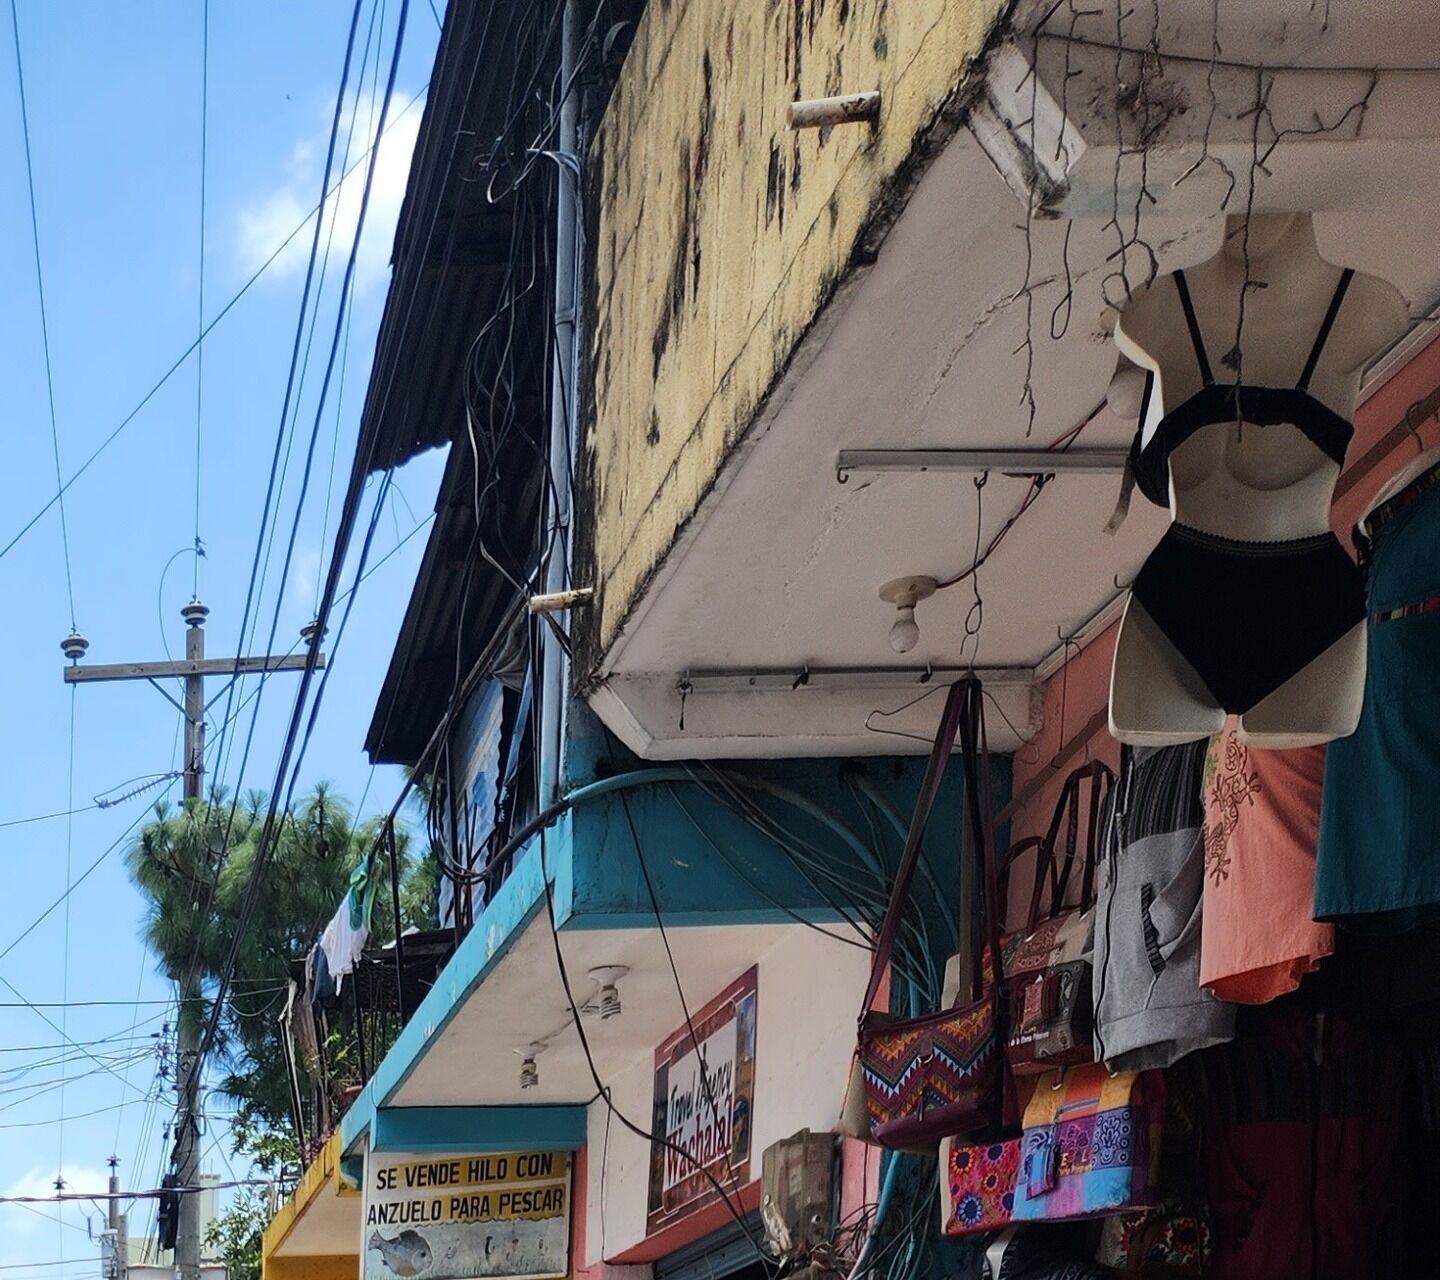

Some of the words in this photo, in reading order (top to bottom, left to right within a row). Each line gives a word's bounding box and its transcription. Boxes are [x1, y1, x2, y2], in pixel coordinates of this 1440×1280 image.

[670, 1071, 696, 1131] Travel
[696, 1058, 733, 1120] Agency
[666, 1092, 733, 1188] Wachalal
[376, 1168, 397, 1191] SE
[404, 1162, 460, 1187] VENDE
[468, 1158, 508, 1183] HILO
[516, 1153, 553, 1178] CON
[367, 1200, 442, 1226] ANZUELO
[450, 1194, 490, 1219] PARA
[499, 1188, 564, 1215] PESCAR
